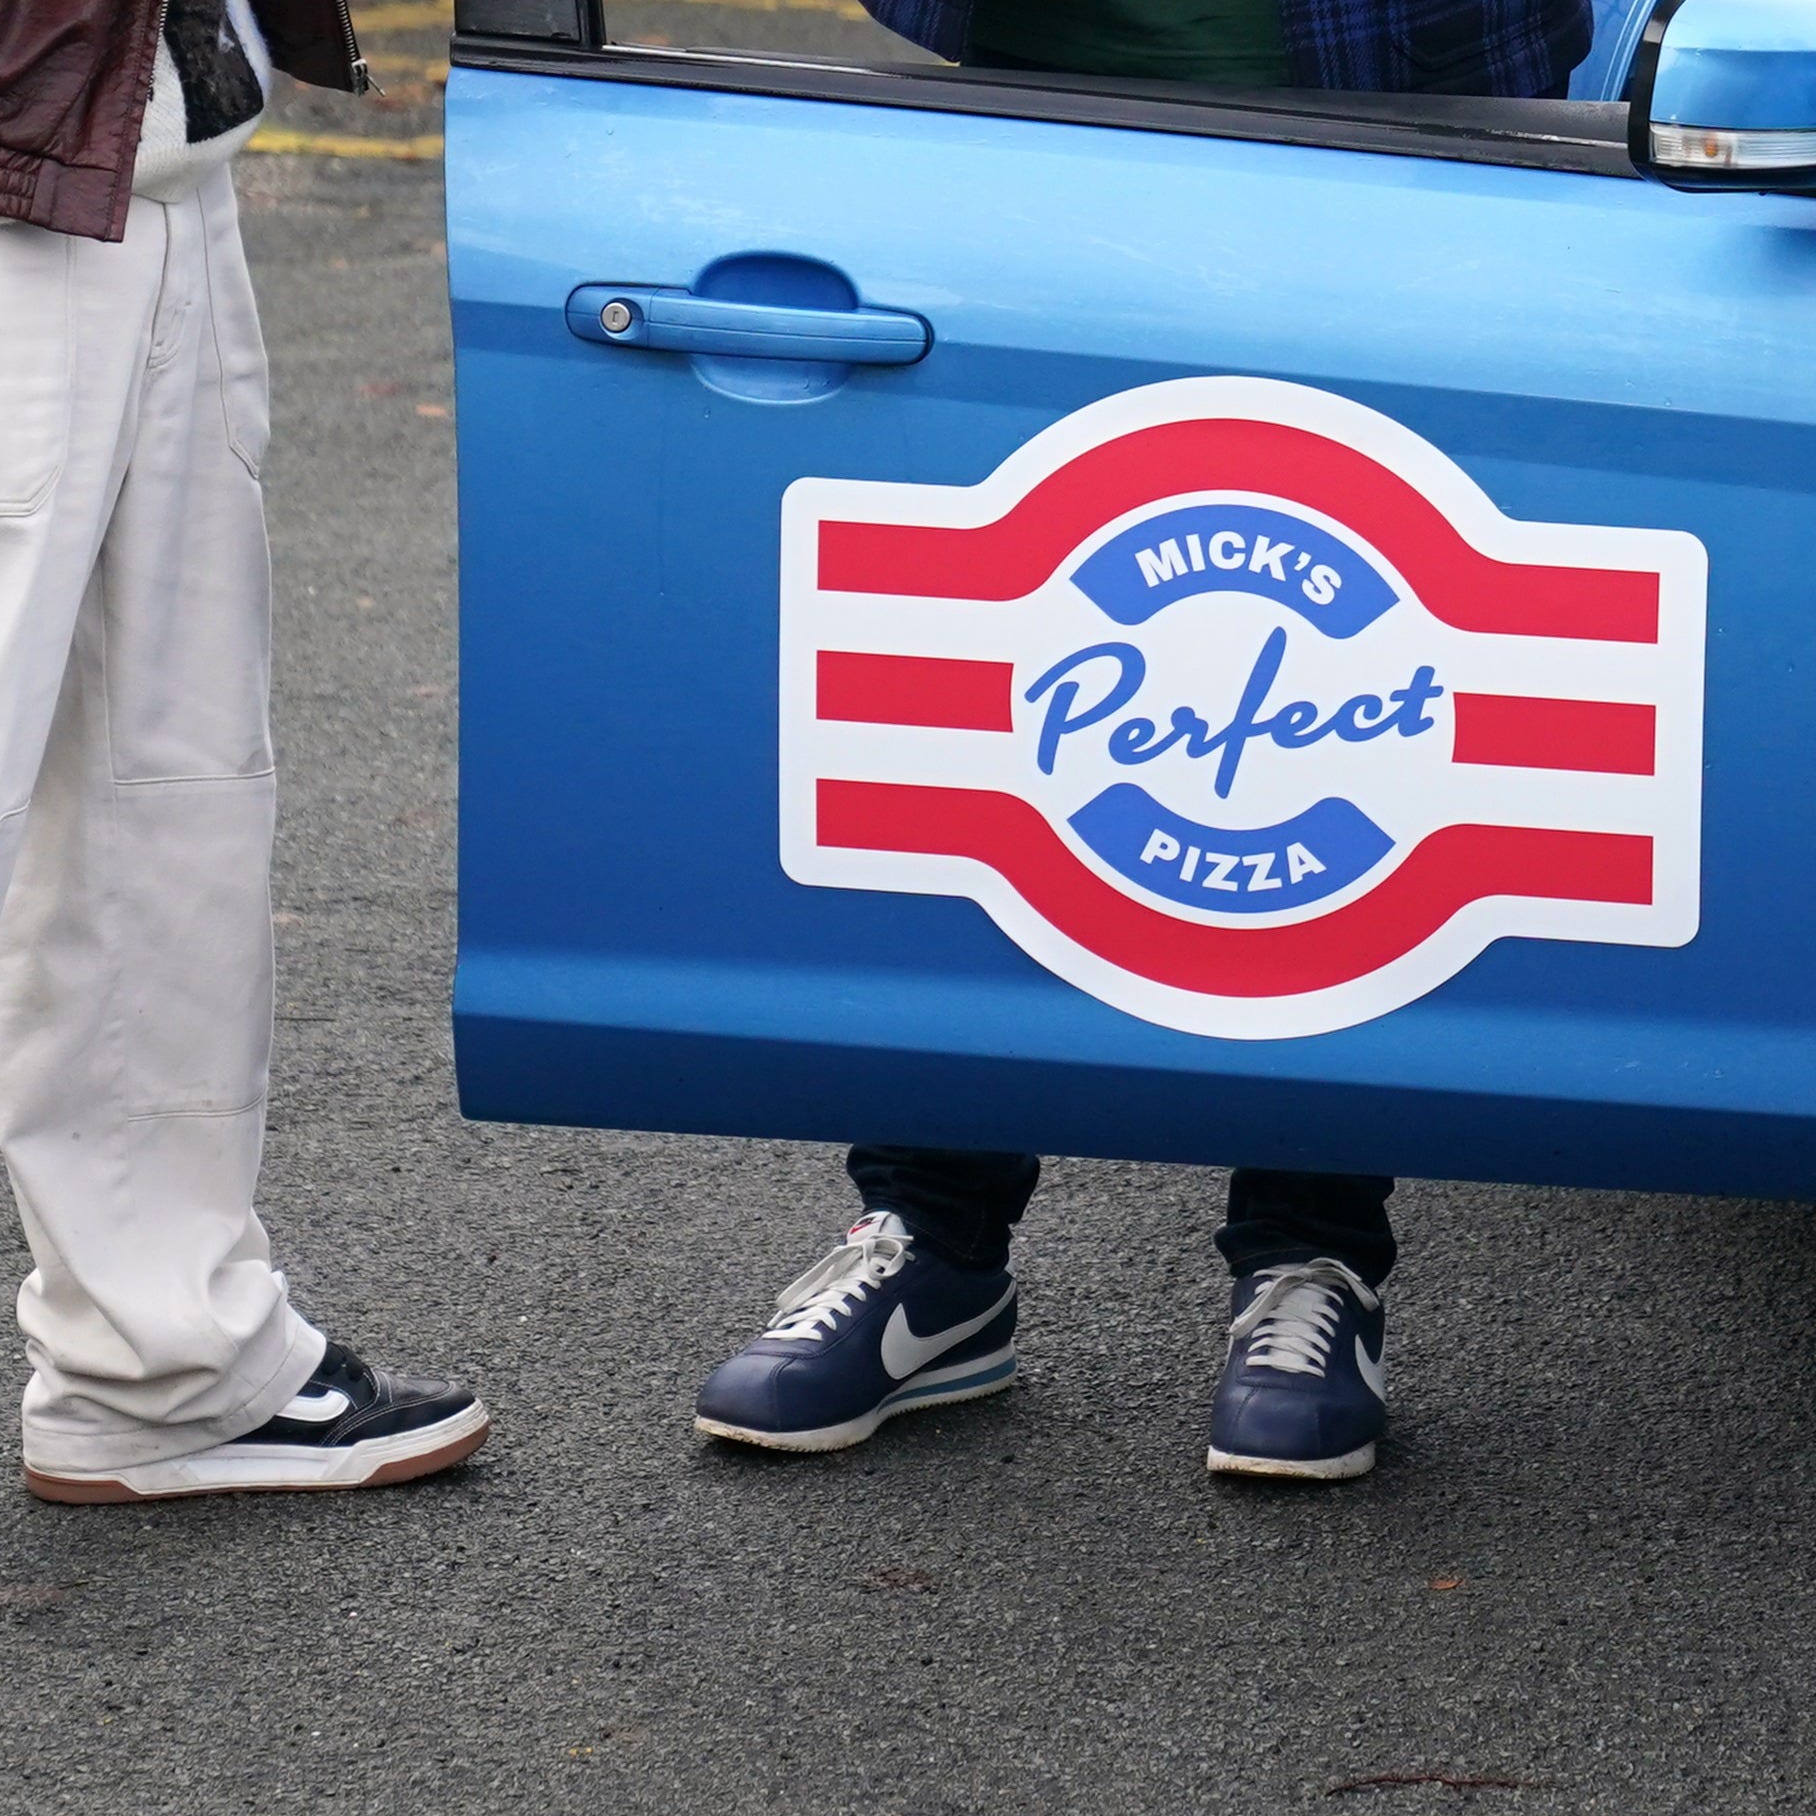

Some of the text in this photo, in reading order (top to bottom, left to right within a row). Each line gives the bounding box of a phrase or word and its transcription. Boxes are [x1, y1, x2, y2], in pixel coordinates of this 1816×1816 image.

[1134, 530, 1343, 606] MICK'S
[1024, 626, 1444, 799] Perfect
[1140, 828, 1328, 893] PIZZA
